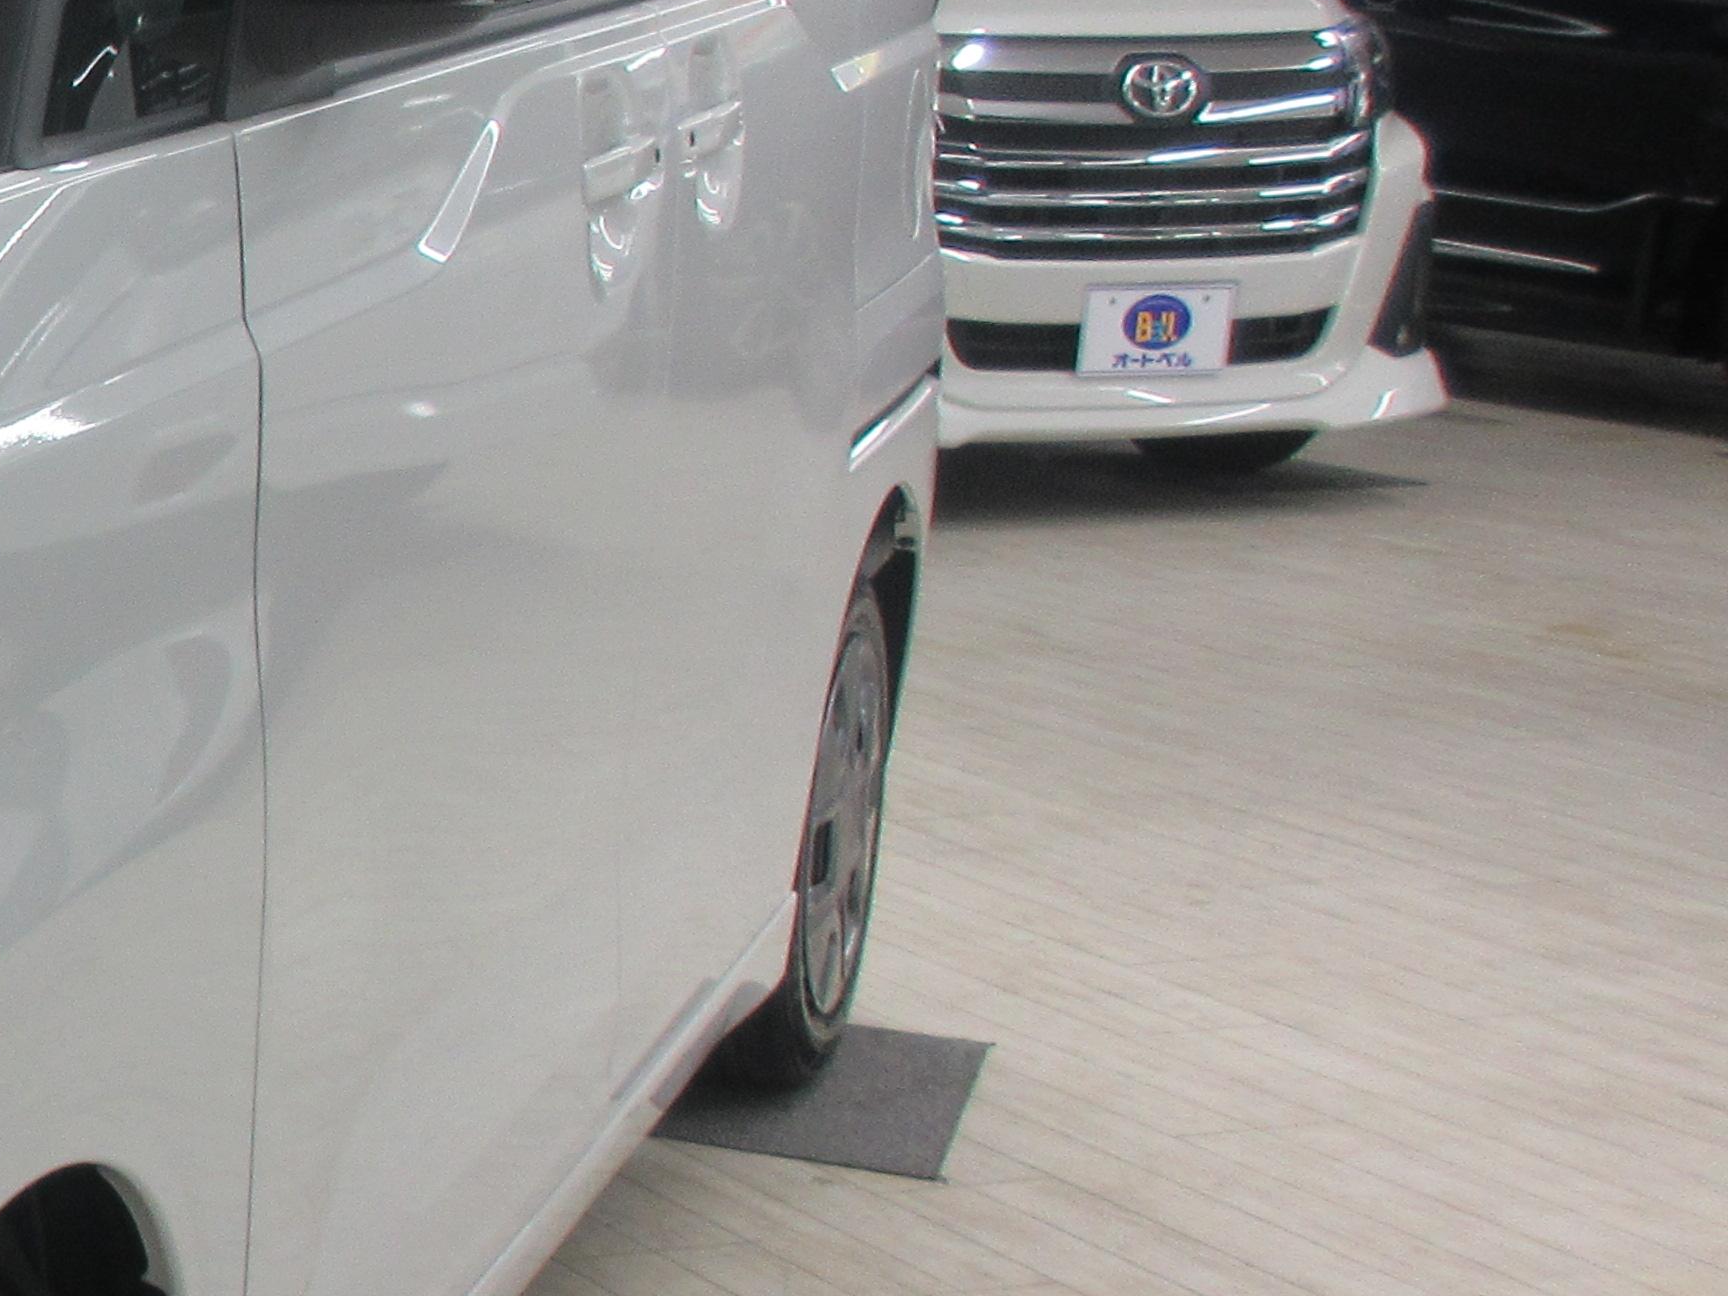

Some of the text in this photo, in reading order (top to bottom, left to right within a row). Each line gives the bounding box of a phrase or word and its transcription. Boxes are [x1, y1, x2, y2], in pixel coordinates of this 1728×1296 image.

[1111, 353, 1192, 368] オートベル
